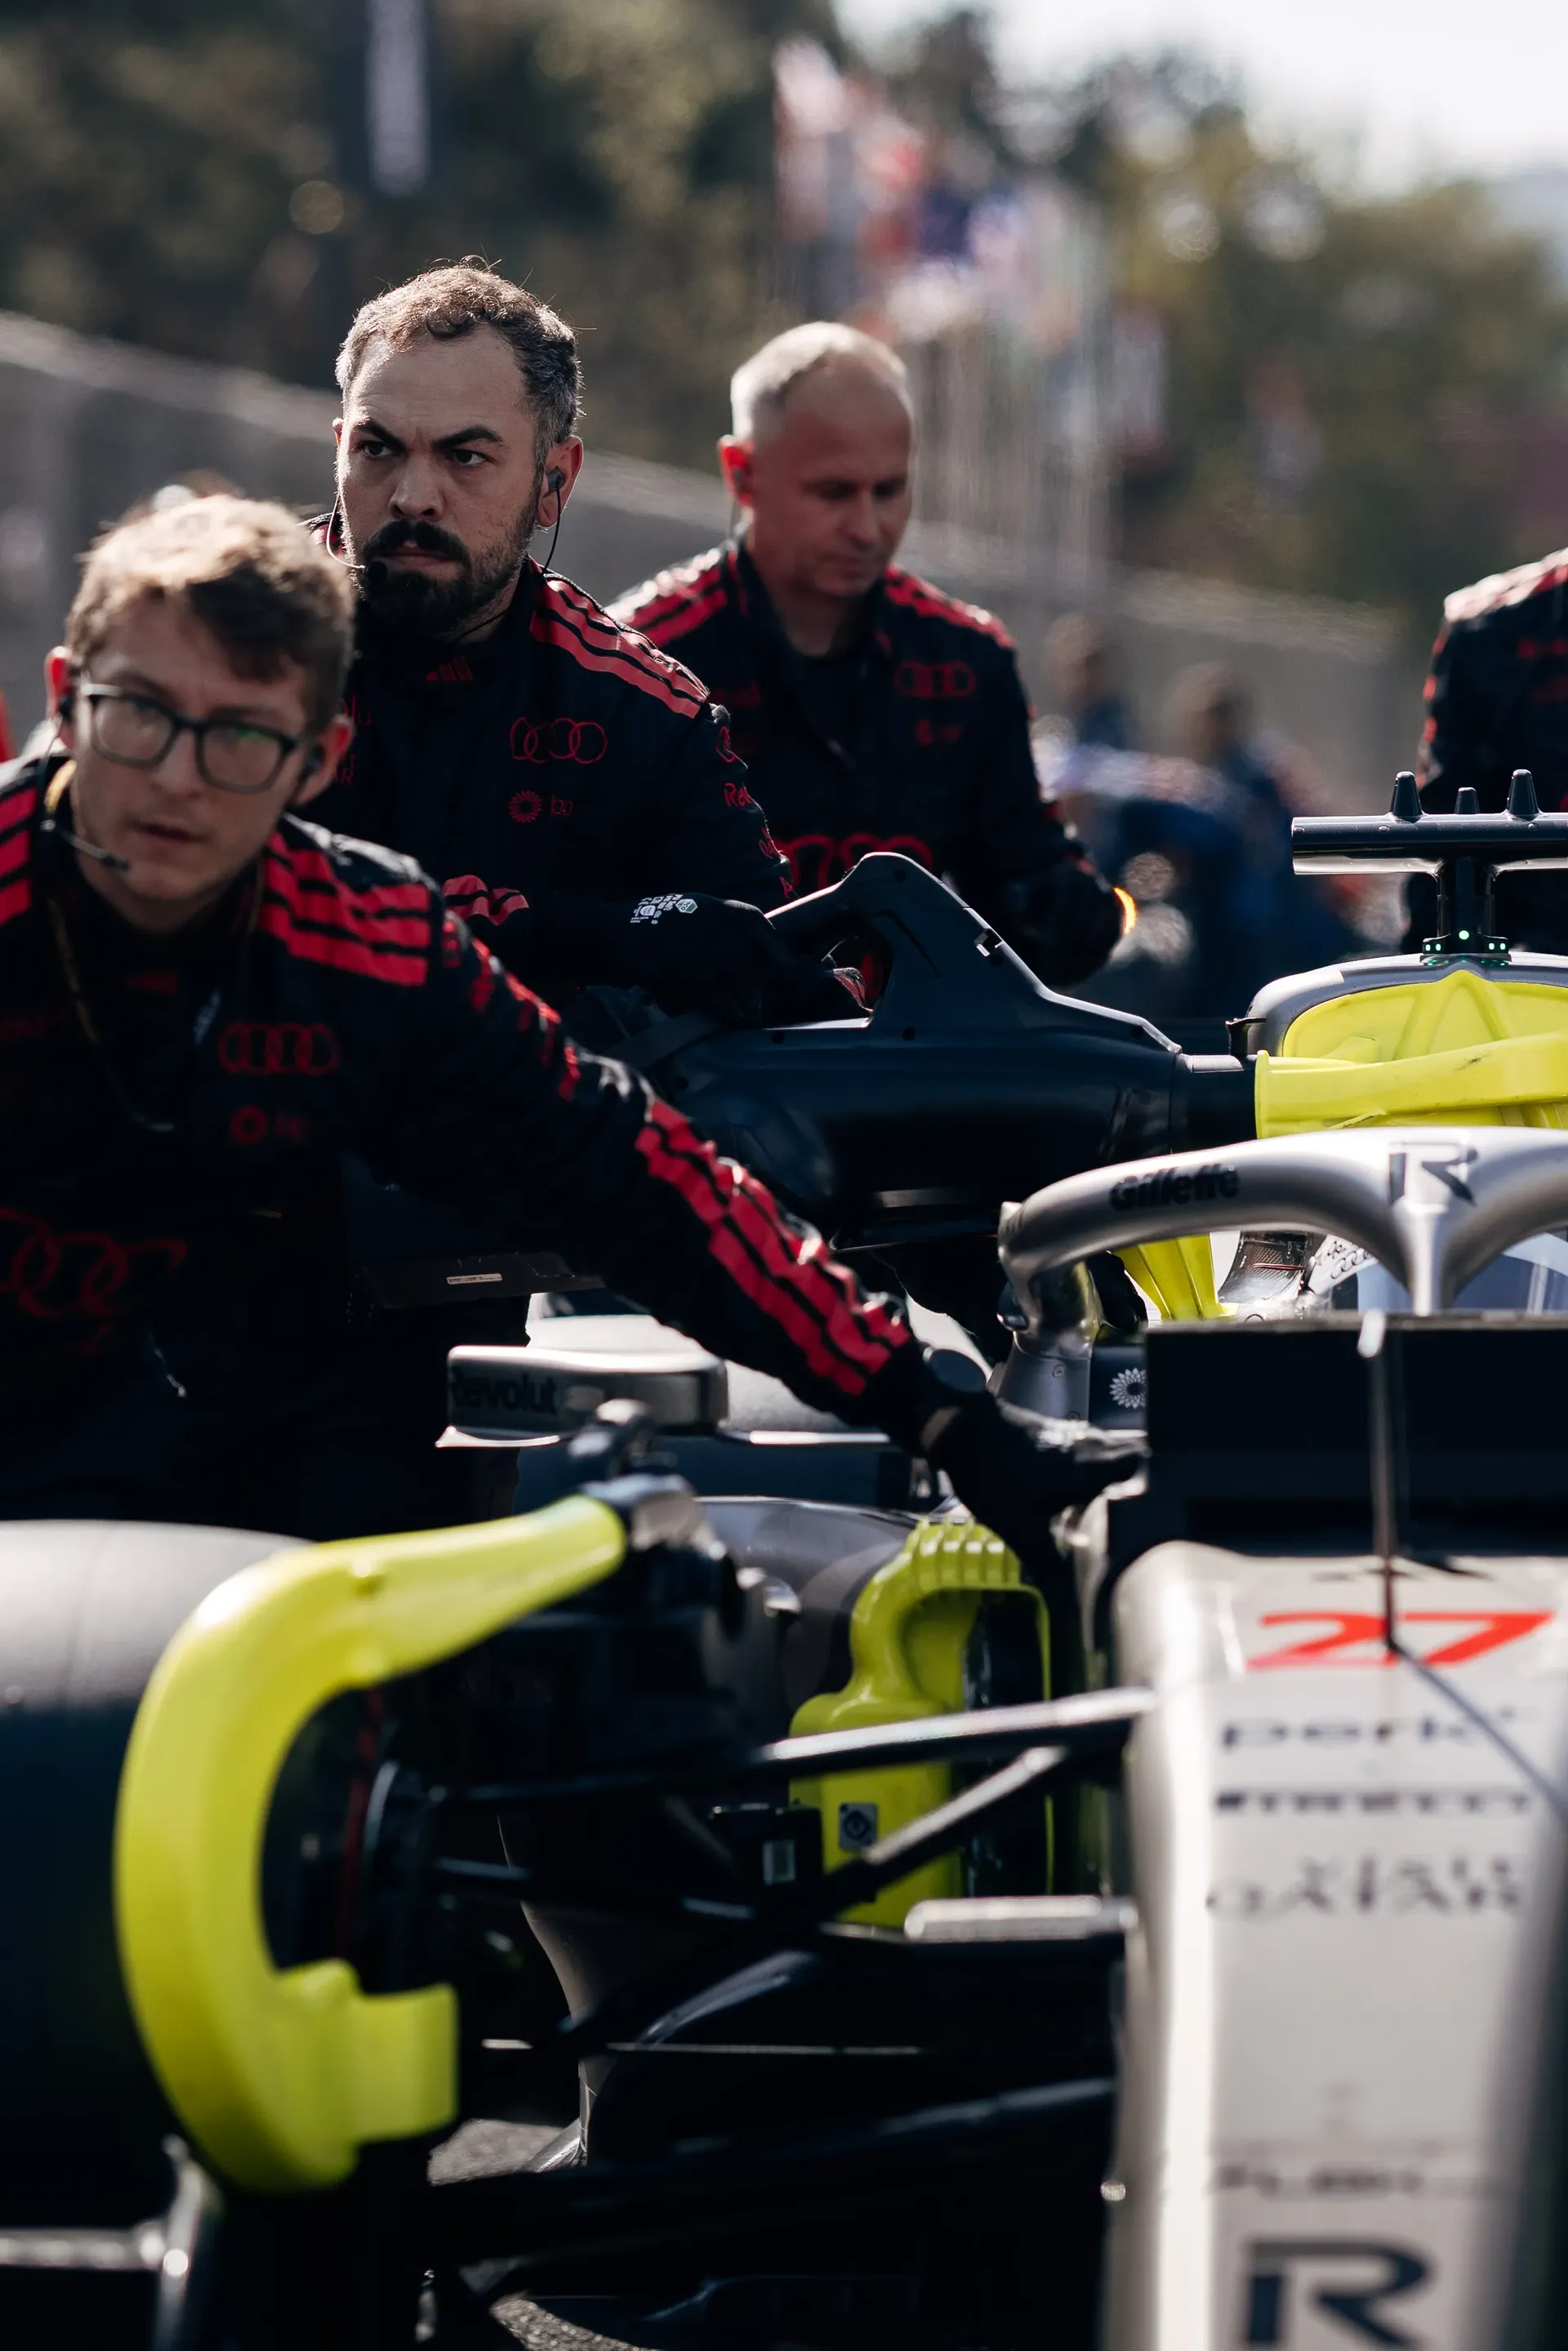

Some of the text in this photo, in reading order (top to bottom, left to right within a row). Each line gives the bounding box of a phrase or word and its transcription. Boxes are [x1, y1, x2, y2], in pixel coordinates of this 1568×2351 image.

[1109, 1163, 1241, 1211] Gillette
[1388, 1142, 1478, 1207] R
[1245, 1610, 1554, 1670] 27
[1248, 2237, 1431, 2349] R
